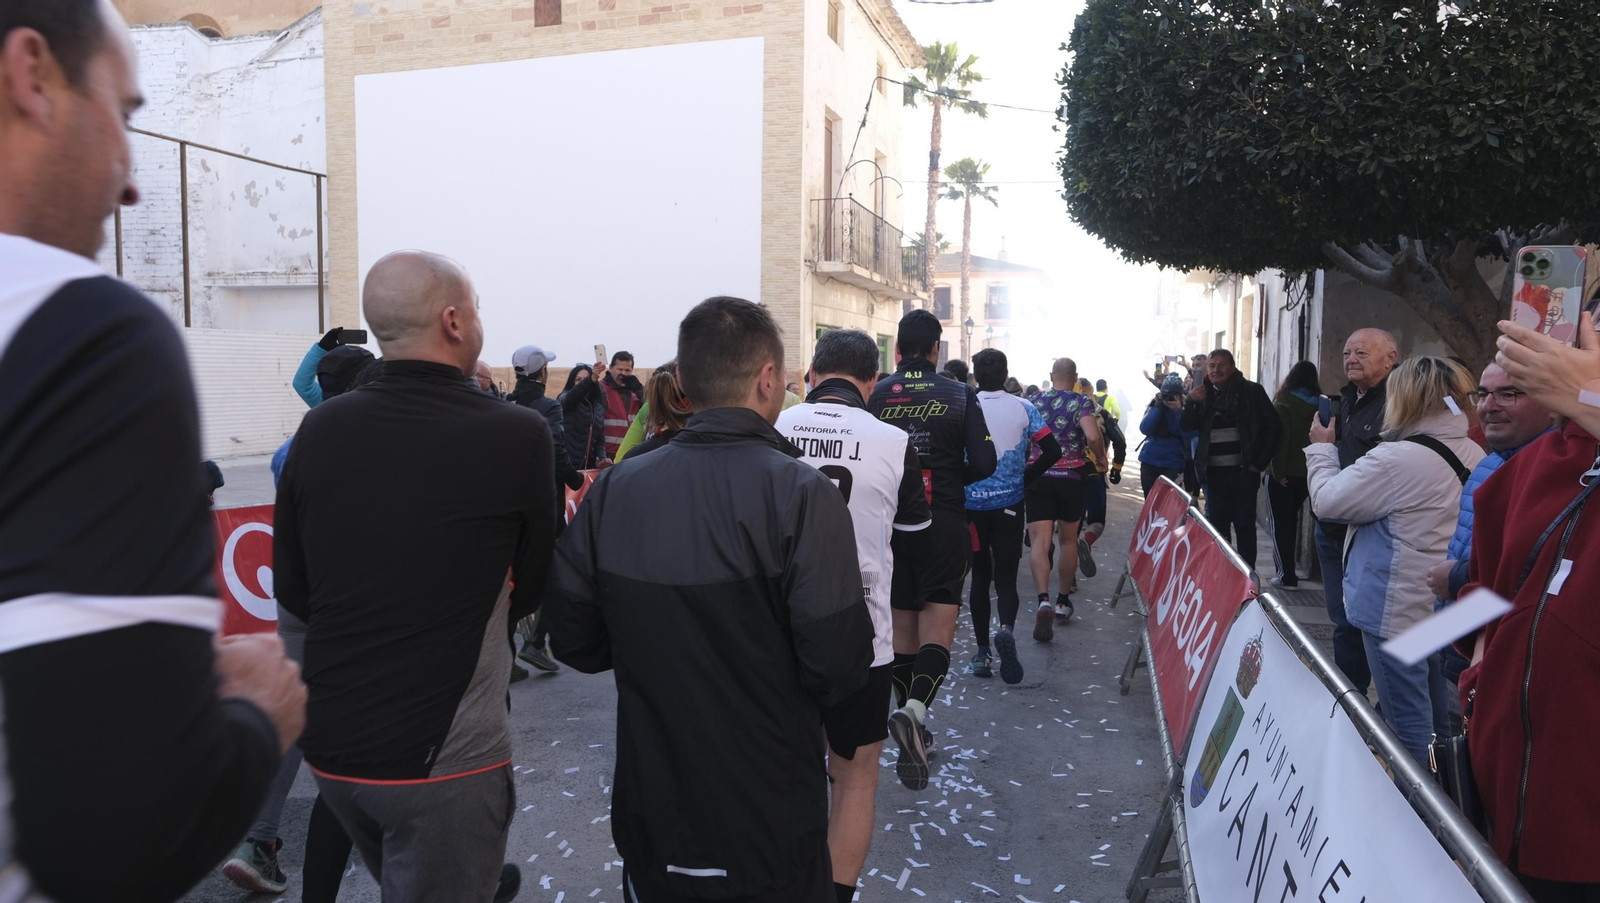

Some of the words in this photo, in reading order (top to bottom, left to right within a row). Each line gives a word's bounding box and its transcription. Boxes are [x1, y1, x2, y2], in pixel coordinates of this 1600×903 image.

[792, 425, 838, 435] CANTORIA
[785, 436, 843, 460] NTONIO
[848, 441, 862, 461] J.
[1252, 702, 1367, 903] AYUNTAMIE
